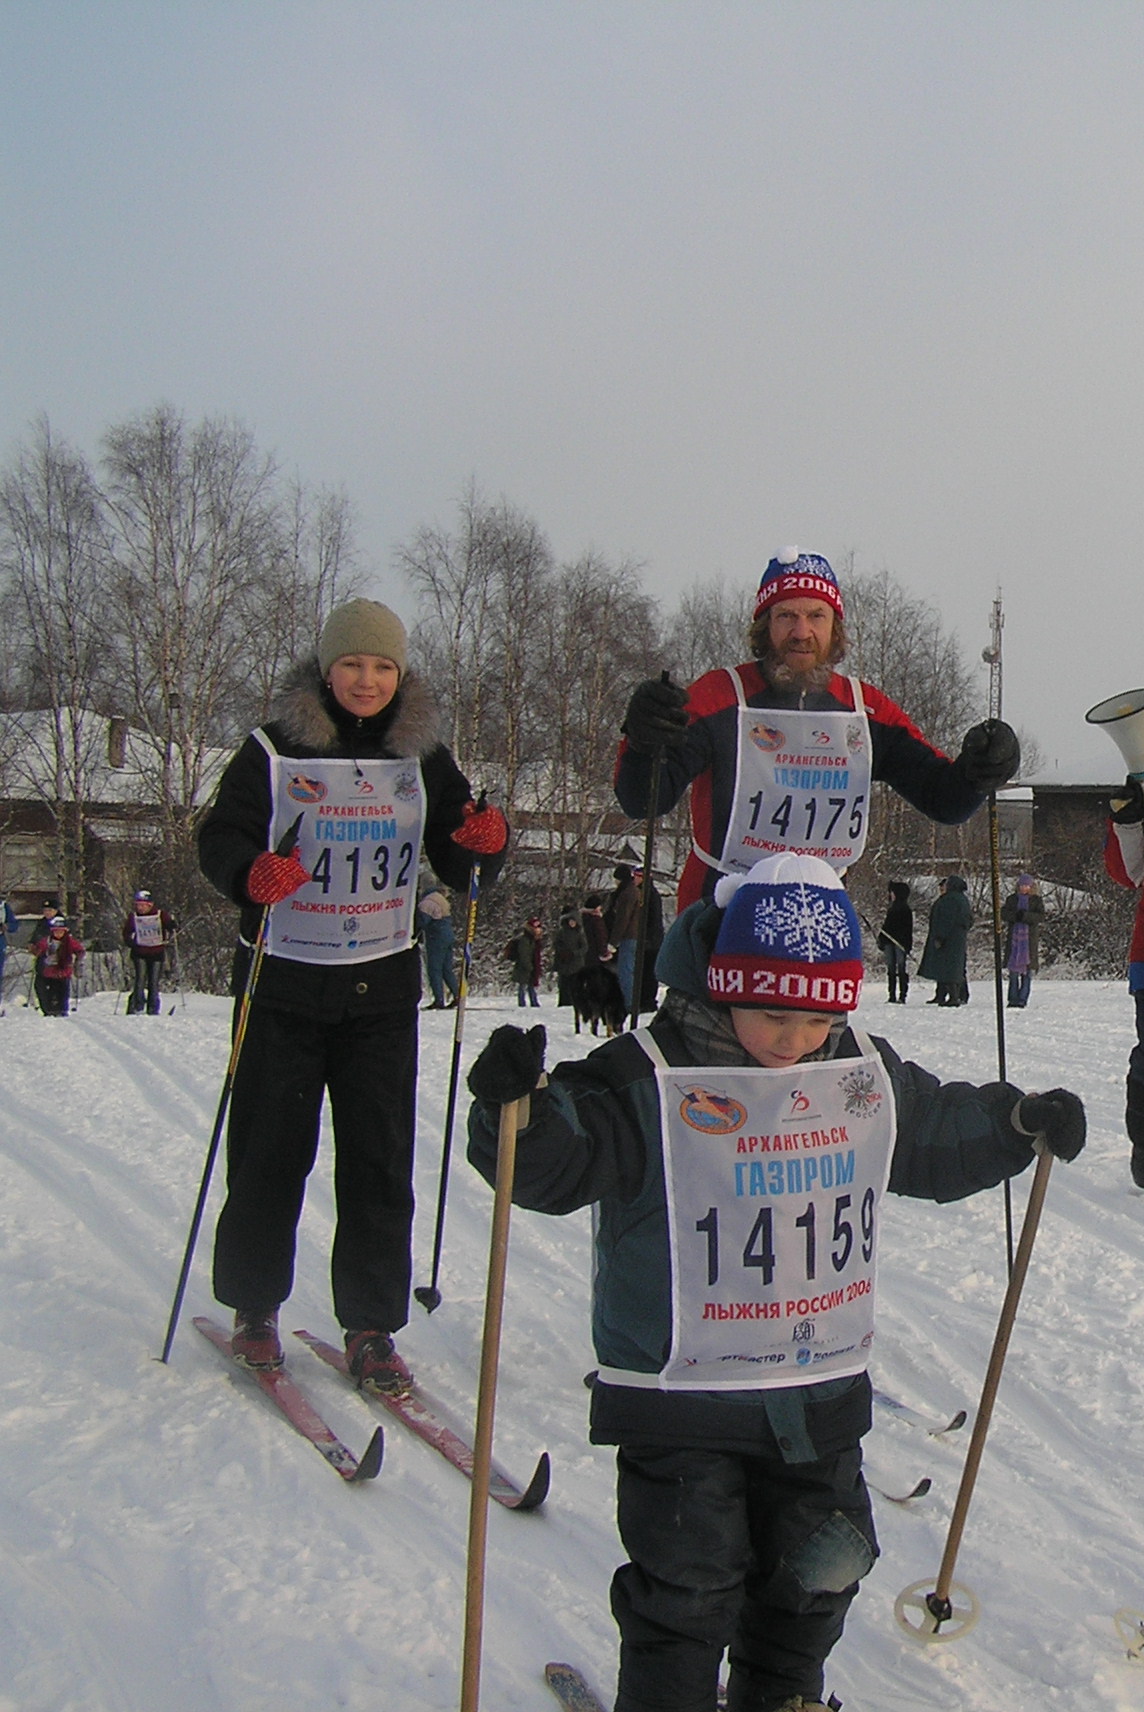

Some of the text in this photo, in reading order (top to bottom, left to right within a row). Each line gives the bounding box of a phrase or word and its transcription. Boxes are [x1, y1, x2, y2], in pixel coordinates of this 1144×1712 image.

[757, 577, 837, 604] НЯ 2006
[775, 753, 848, 766] АРХАНГЕЛЬСК
[774, 767, 849, 790] ГАЗПРОМ
[319, 804, 394, 817] АРХАНГЕЛЬСК
[749, 791, 864, 840] 14175
[315, 818, 397, 842] ГАЗПРОМ
[742, 836, 786, 853] ЛЫЖНЯ
[831, 847, 853, 857] 2006
[312, 842, 413, 895] 4132
[291, 901, 336, 914] ЛЫЖНЯ
[339, 902, 383, 915] РОССИИ
[752, 970, 854, 1004] 2006
[736, 1126, 849, 1153] АРХАНГЕЛЬСК
[734, 1150, 855, 1197] ГАЗПРОМ
[696, 1187, 875, 1286] 14159
[702, 1278, 872, 1320] ЛЫЖНЯ РОССИИ 2006
